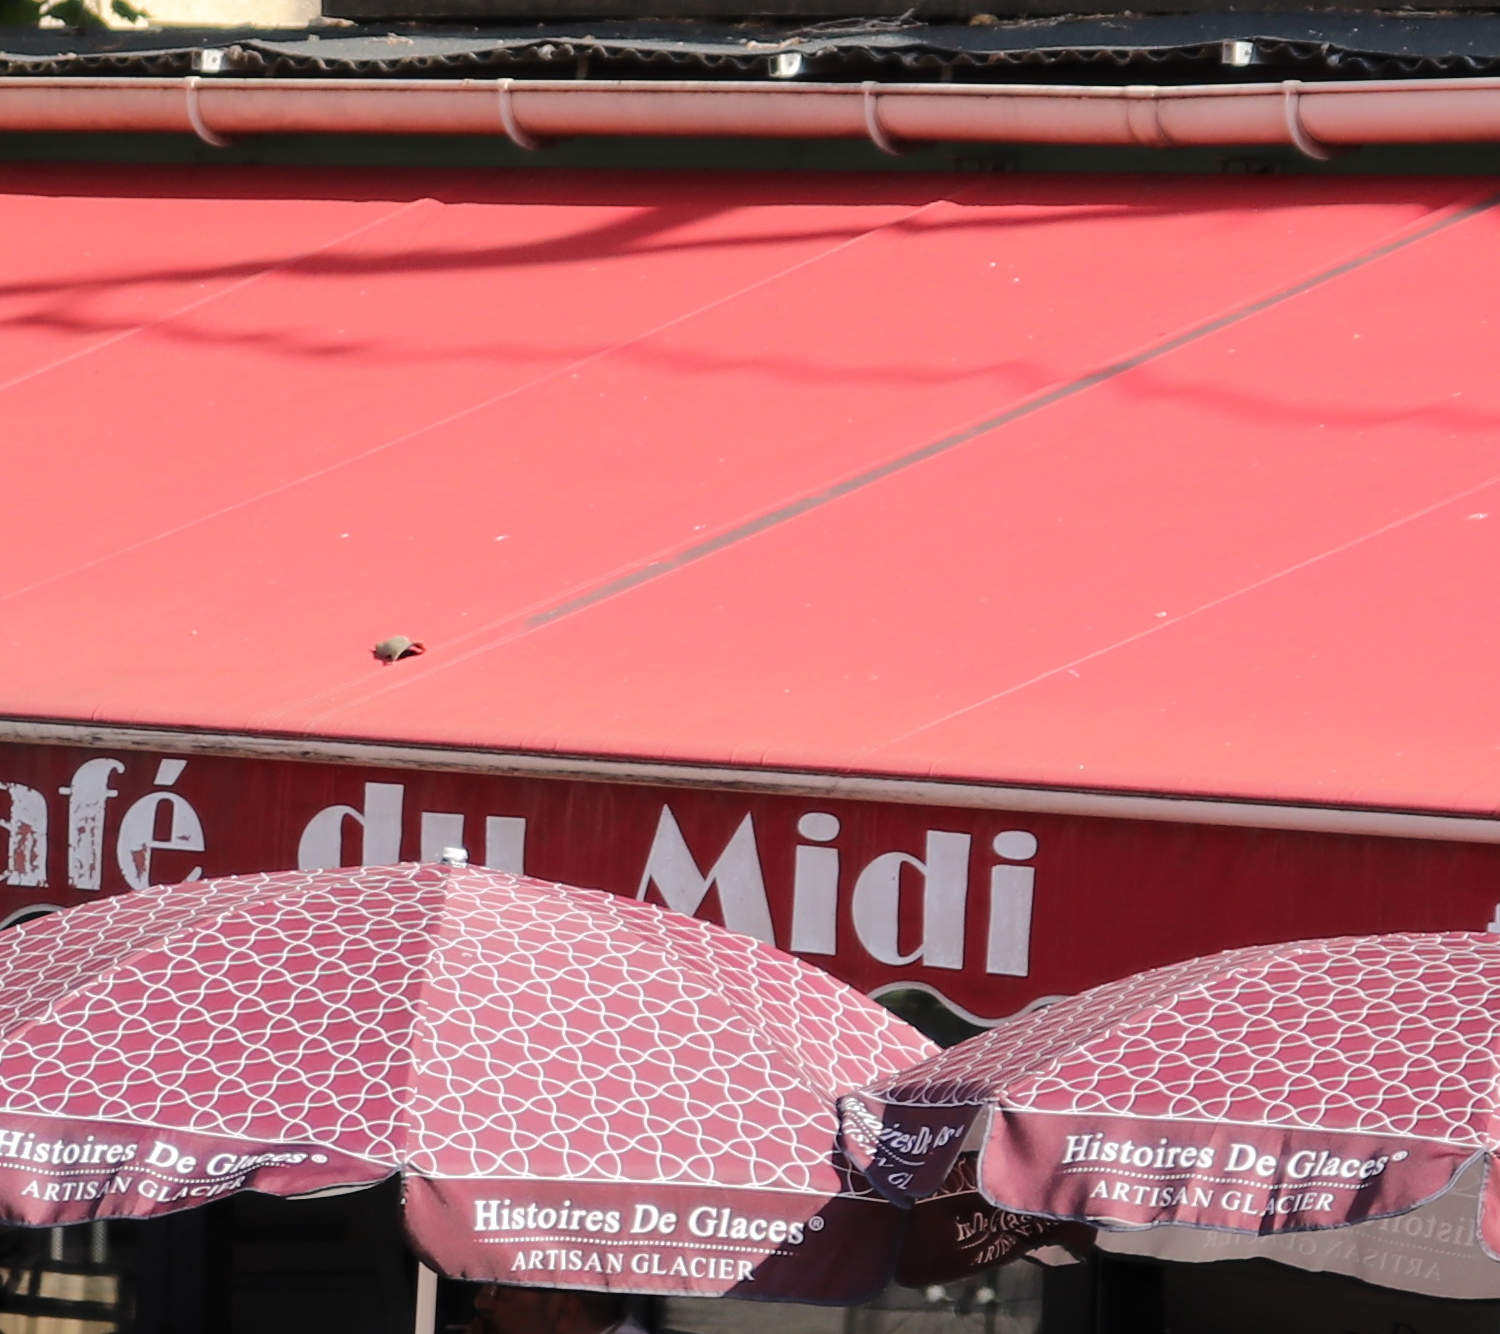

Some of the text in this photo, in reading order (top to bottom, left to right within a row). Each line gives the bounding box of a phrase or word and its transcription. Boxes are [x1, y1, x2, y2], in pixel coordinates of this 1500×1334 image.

[635, 803, 1039, 978] Midi
[146, 1141, 196, 1174] De
[1062, 1132, 1214, 1170] Histoires
[1224, 1144, 1276, 1177] De
[22, 1175, 246, 1202] ARTISAN GLACIER
[1090, 1180, 1336, 1216] ARTISAN GLACIER
[474, 1199, 622, 1234] Histoires
[630, 1204, 677, 1233] De
[511, 1249, 756, 1282] ARTISAN GLACIER
